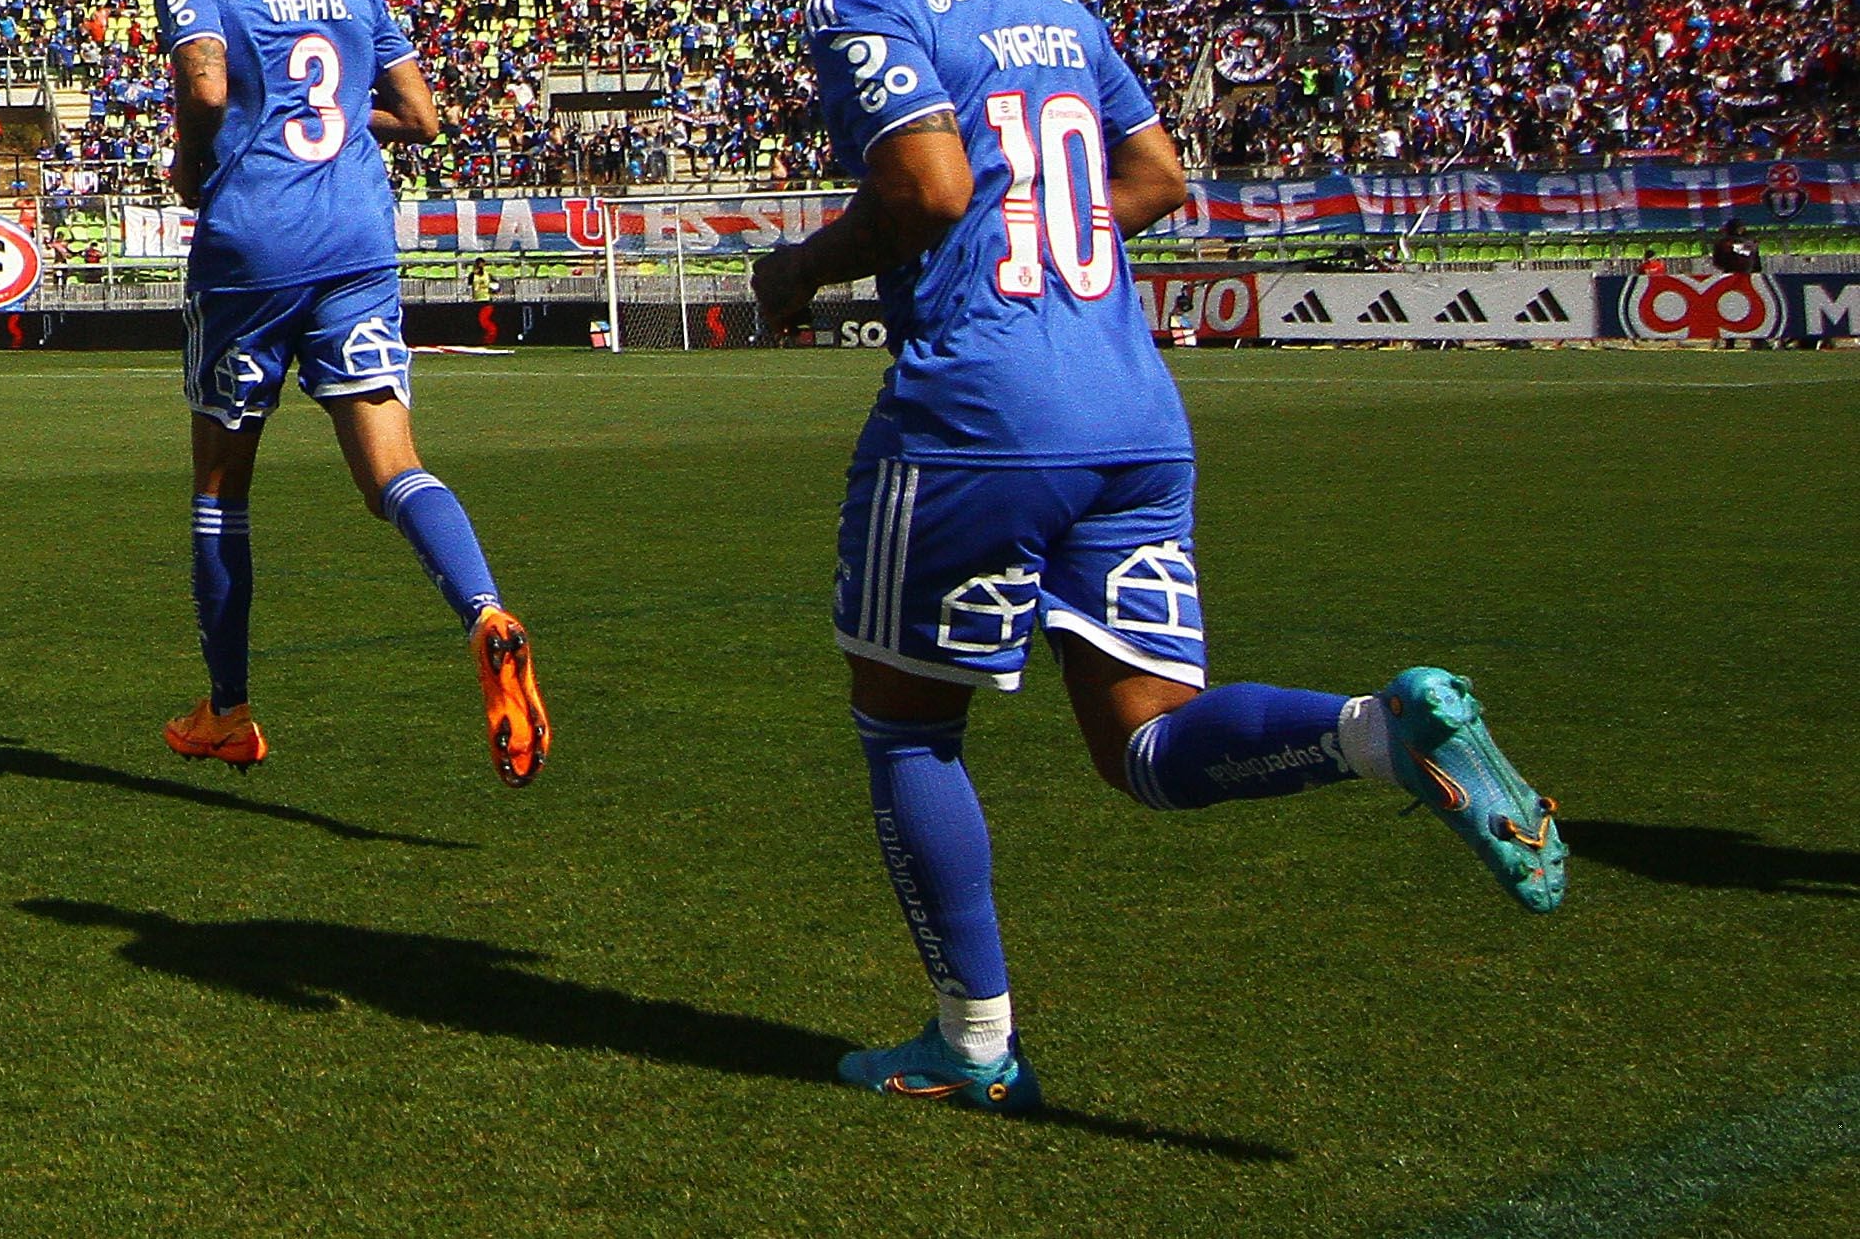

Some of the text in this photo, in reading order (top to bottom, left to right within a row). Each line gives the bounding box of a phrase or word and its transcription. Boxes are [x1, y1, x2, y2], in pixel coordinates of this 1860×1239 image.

[283, 33, 348, 161] 3
[978, 25, 1085, 71] VARGAS
[456, 199, 540, 251] LA
[562, 197, 621, 251] U
[1240, 178, 1320, 238] SE
[1537, 166, 1640, 231] SIN
[985, 90, 1116, 301] 10
